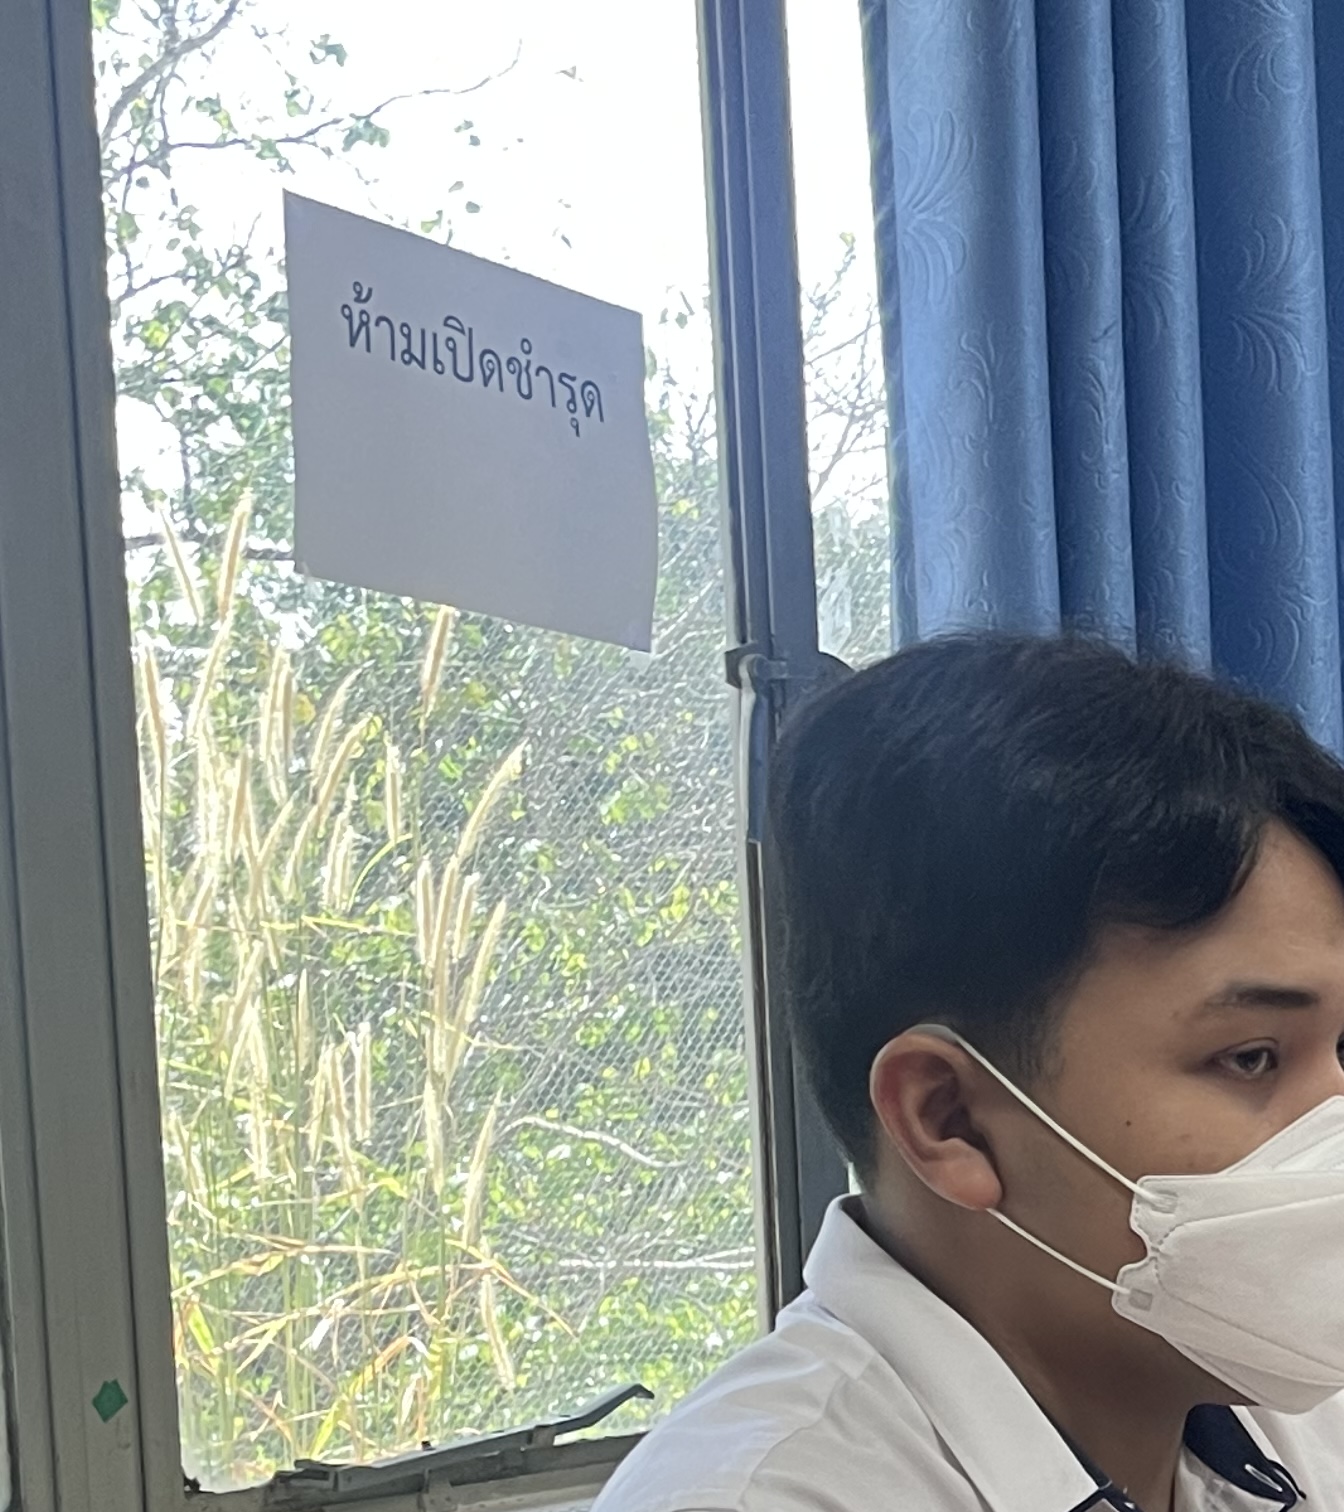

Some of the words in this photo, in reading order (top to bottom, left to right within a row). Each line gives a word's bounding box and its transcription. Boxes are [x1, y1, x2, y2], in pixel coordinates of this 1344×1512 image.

[340, 281, 606, 438] ห้ามเปิดชำรุด
